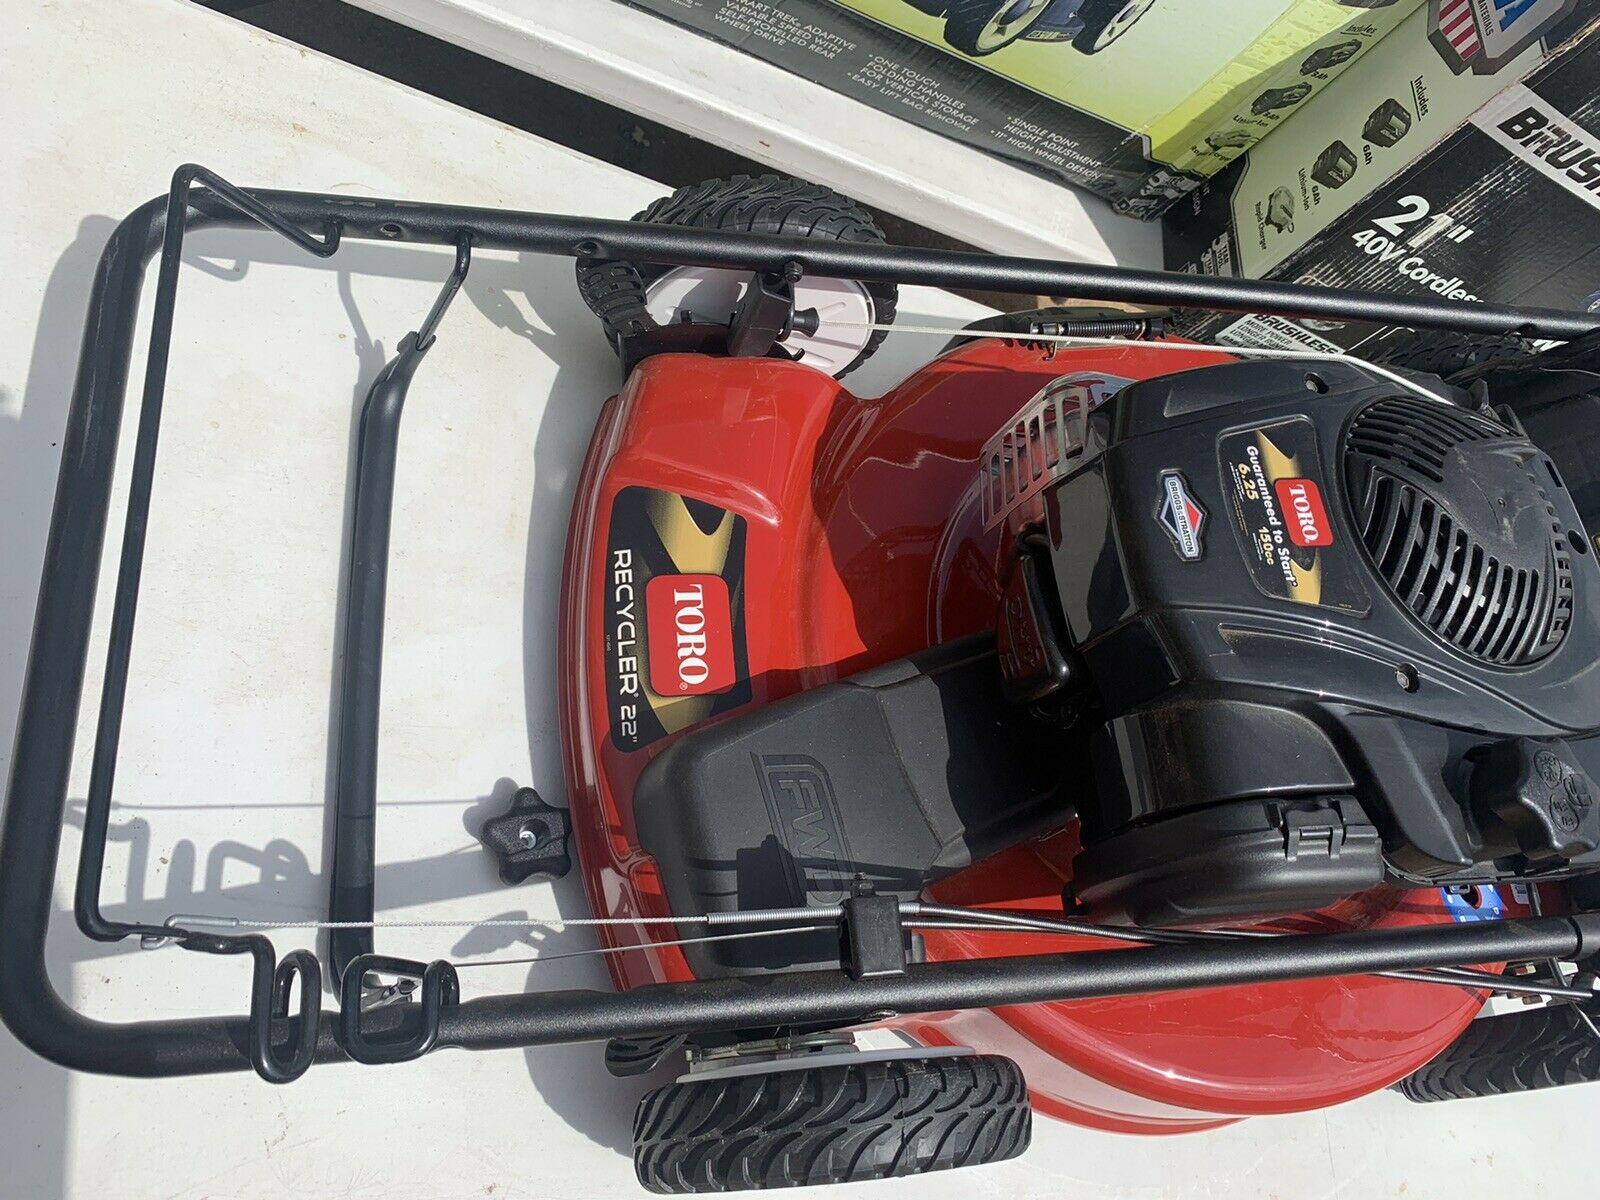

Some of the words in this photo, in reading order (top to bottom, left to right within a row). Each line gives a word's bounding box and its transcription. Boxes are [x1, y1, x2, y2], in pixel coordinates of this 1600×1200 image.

[714, 13, 751, 33] WHEEL
[753, 28, 787, 47] DRIVE
[718, 8, 807, 47] SELF-PROPELLED
[809, 43, 837, 60] REAR
[726, 1, 777, 25] VARIABLE
[778, 18, 812, 40] SPEED
[814, 36, 843, 54] WITH
[735, 0, 772, 12] MART
[803, 24, 858, 51] ADAPTIVE
[867, 61, 917, 87] FOLDING
[917, 85, 966, 110] HANDLES
[875, 56, 900, 71] ONE
[901, 68, 941, 89] TOUCH
[852, 74, 880, 89] EASY
[880, 87, 902, 100] LIFT
[901, 97, 925, 111] BAG
[924, 108, 971, 132] REMOVAL
[860, 68, 883, 81] FOR
[885, 78, 930, 104] VERTICAL
[932, 101, 980, 126] STORAGE
[1414, 75, 1430, 117] Includes
[1003, 123, 1043, 144] HEIGHT
[1040, 138, 1102, 168] ADJUSTMENT
[1011, 117, 1049, 136] SINGLE
[1048, 131, 1080, 149] POINT
[1363, 144, 1373, 165] 6Ah
[1008, 135, 1034, 152] HIGH
[1035, 147, 1065, 166] WHEEL
[1065, 161, 1102, 181] DESIGN
[1371, 194, 1475, 249] 21"
[1352, 228, 1407, 262] 40V
[1398, 257, 1484, 303] Cordle
[1236, 324, 1265, 342] LONGER
[1243, 320, 1267, 333] MORE
[1266, 327, 1293, 345] POWER
[1237, 462, 1260, 501] 6.25
[1246, 445, 1282, 526] Guaranteed
[1273, 529, 1283, 544] to
[1168, 480, 1183, 510] BRIGGS
[1178, 516, 1195, 553] STRATTON
[1258, 526, 1274, 566] 150cc
[620, 705, 638, 743] 22"
